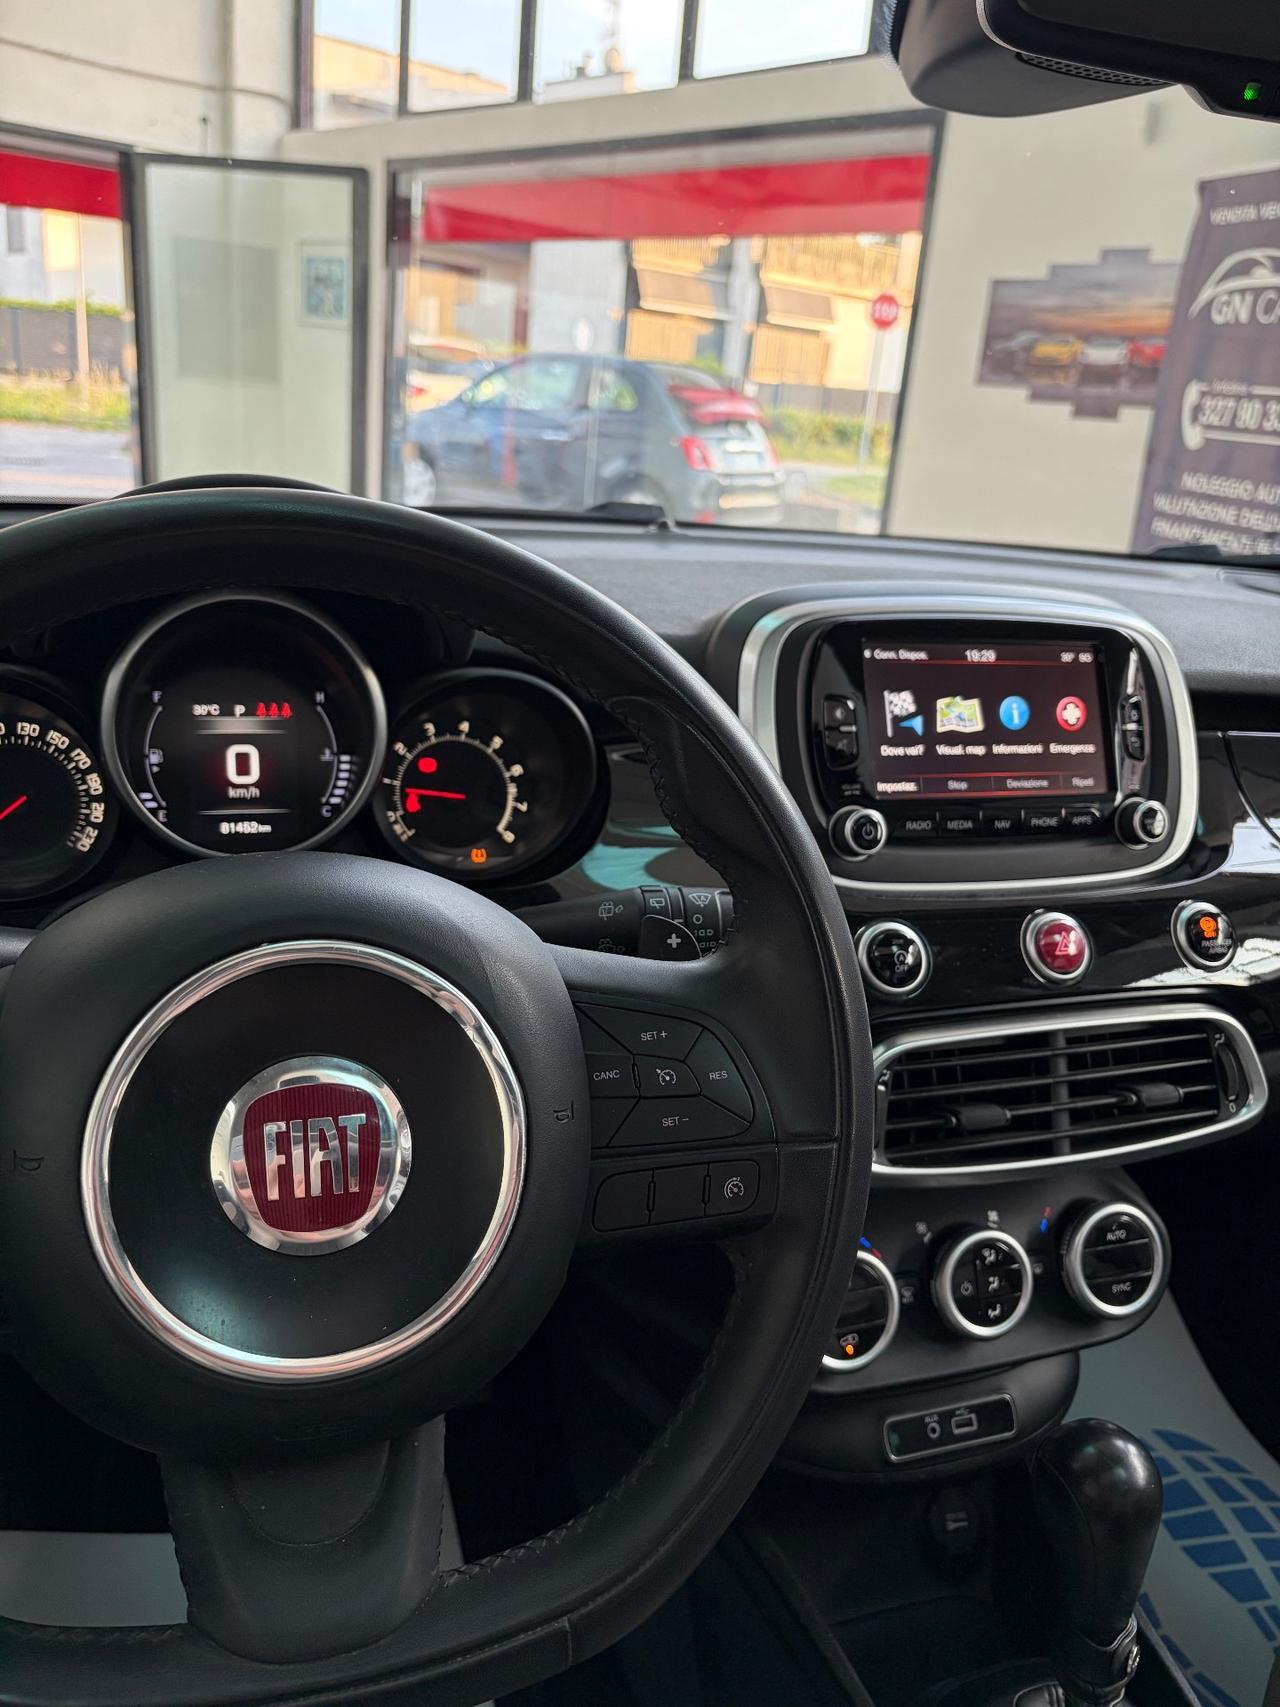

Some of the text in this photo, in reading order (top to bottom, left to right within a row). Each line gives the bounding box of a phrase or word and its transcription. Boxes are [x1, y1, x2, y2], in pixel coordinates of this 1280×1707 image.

[1210, 292, 1254, 325] GN
[234, 704, 246, 718] P
[16, 721, 40, 738] 130
[46, 729, 70, 750] 150
[992, 743, 1043, 755] Informazioni
[1049, 743, 1096, 755] Emergenza
[69, 748, 92, 770] 170
[226, 743, 260, 785] 0
[227, 787, 261, 799] km/h
[906, 820, 932, 831] RADIO
[947, 819, 973, 830] MEDIA
[994, 819, 1011, 830] NAV
[1031, 816, 1059, 828] PHONE
[1072, 815, 1092, 825] APPS
[76, 826, 99, 852] 230
[640, 1031, 659, 1041] SET
[593, 1069, 620, 1080] CANC
[709, 1070, 728, 1081] RES
[662, 1116, 680, 1127] SET
[263, 1113, 367, 1202] FIAT
[1106, 1229, 1127, 1241] AUTO
